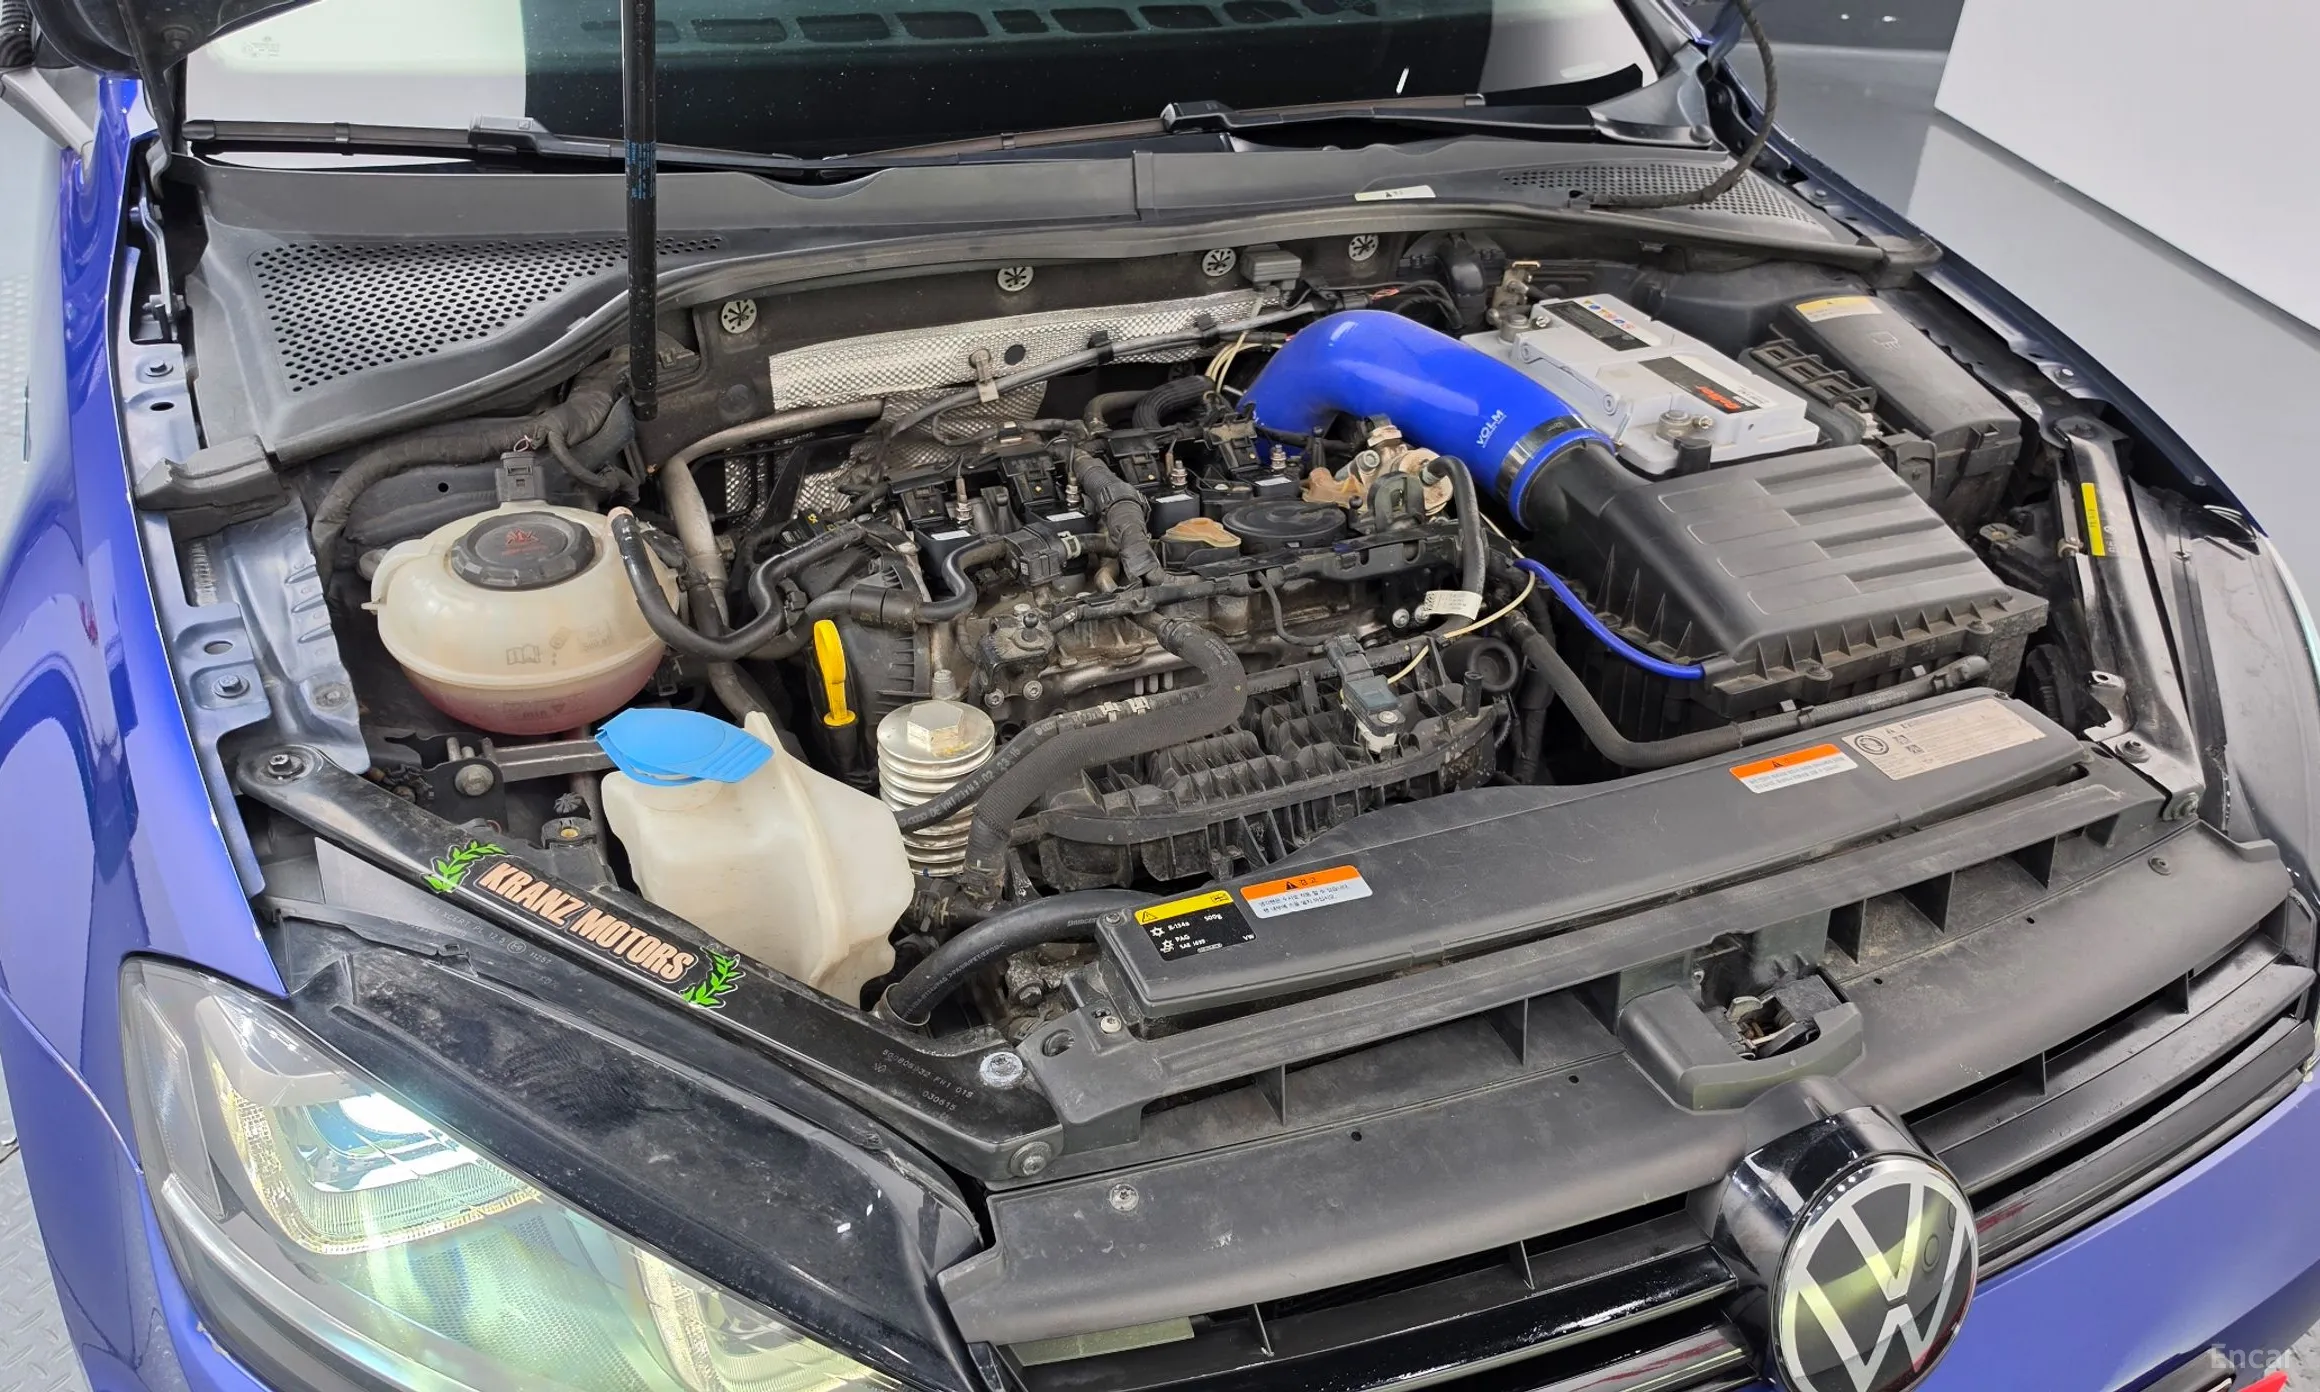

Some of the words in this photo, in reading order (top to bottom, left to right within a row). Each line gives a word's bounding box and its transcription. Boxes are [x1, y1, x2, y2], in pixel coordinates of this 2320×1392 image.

[1476, 409, 1504, 445] VOLM
[478, 862, 586, 926] KRANZ
[570, 907, 694, 980] MOTORS
[1175, 934, 1190, 942] PAG
